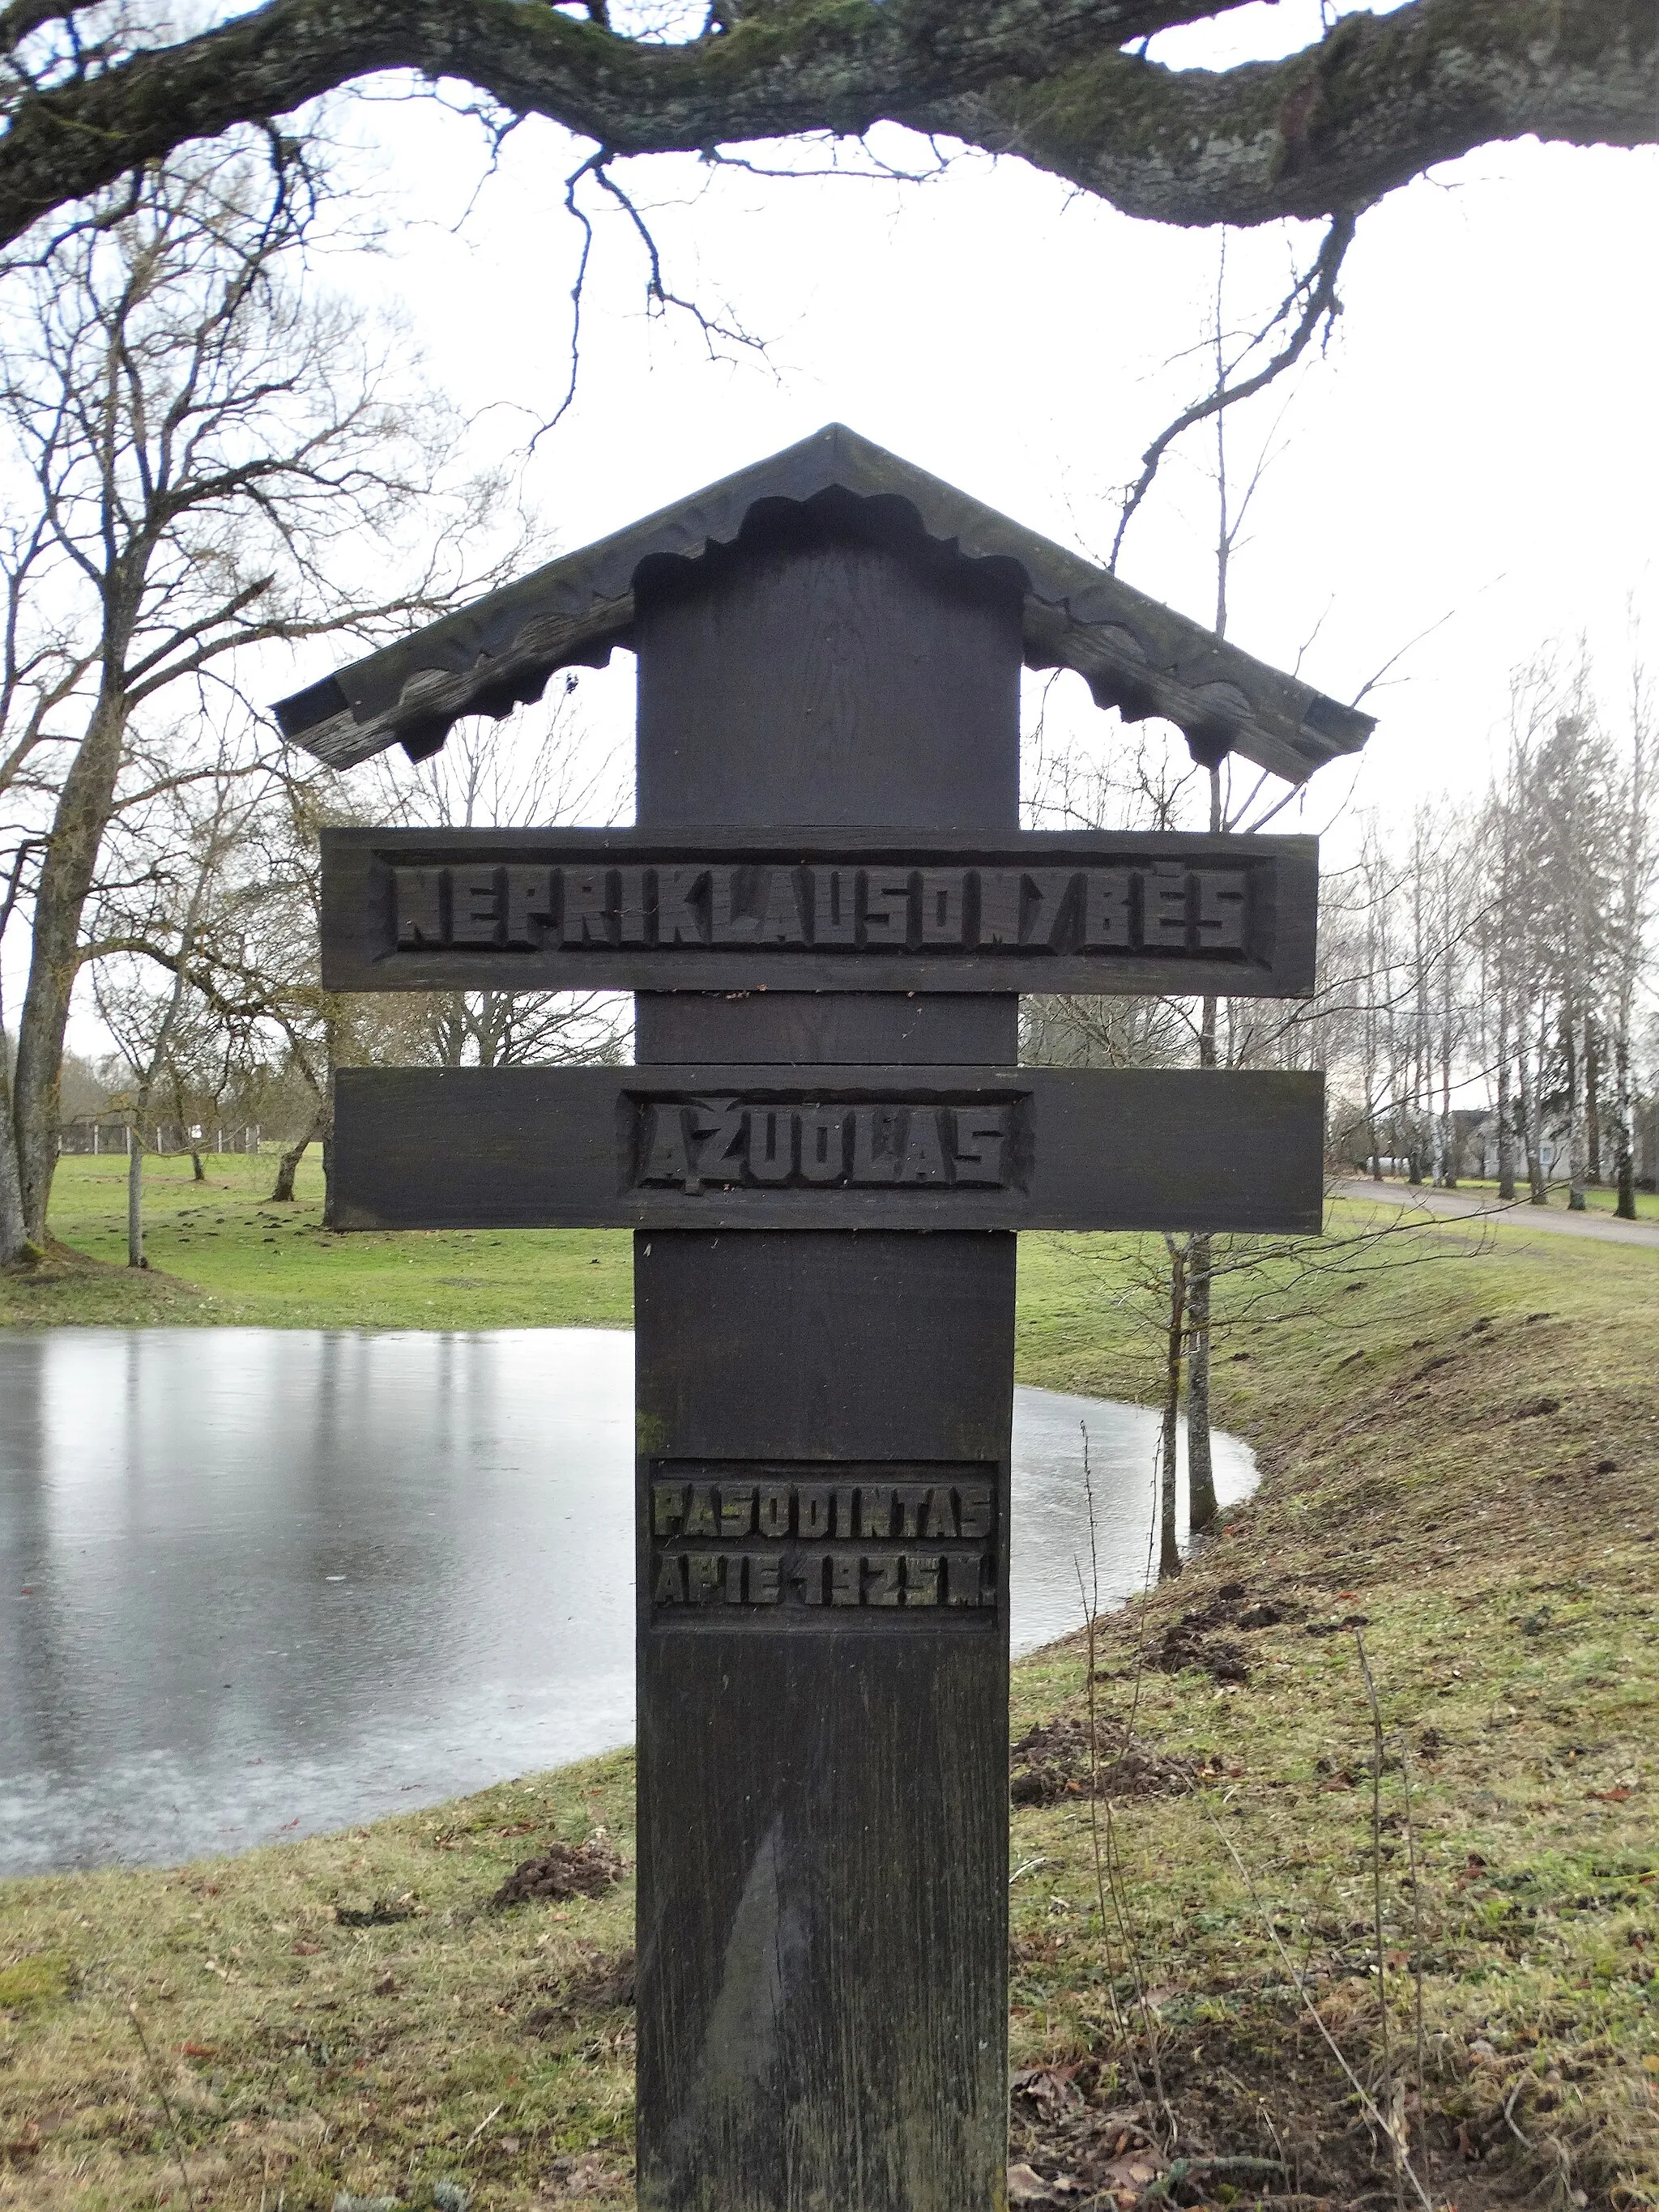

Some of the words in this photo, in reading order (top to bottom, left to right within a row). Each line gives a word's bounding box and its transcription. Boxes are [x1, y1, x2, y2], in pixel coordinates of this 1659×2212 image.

[397, 861, 1243, 951] NEPRIKLAUSOMYBĖS
[640, 1097, 1004, 1195] ĄŽUOLAS
[654, 1482, 992, 1538] PASODINTAS
[655, 1551, 778, 1604] APIE
